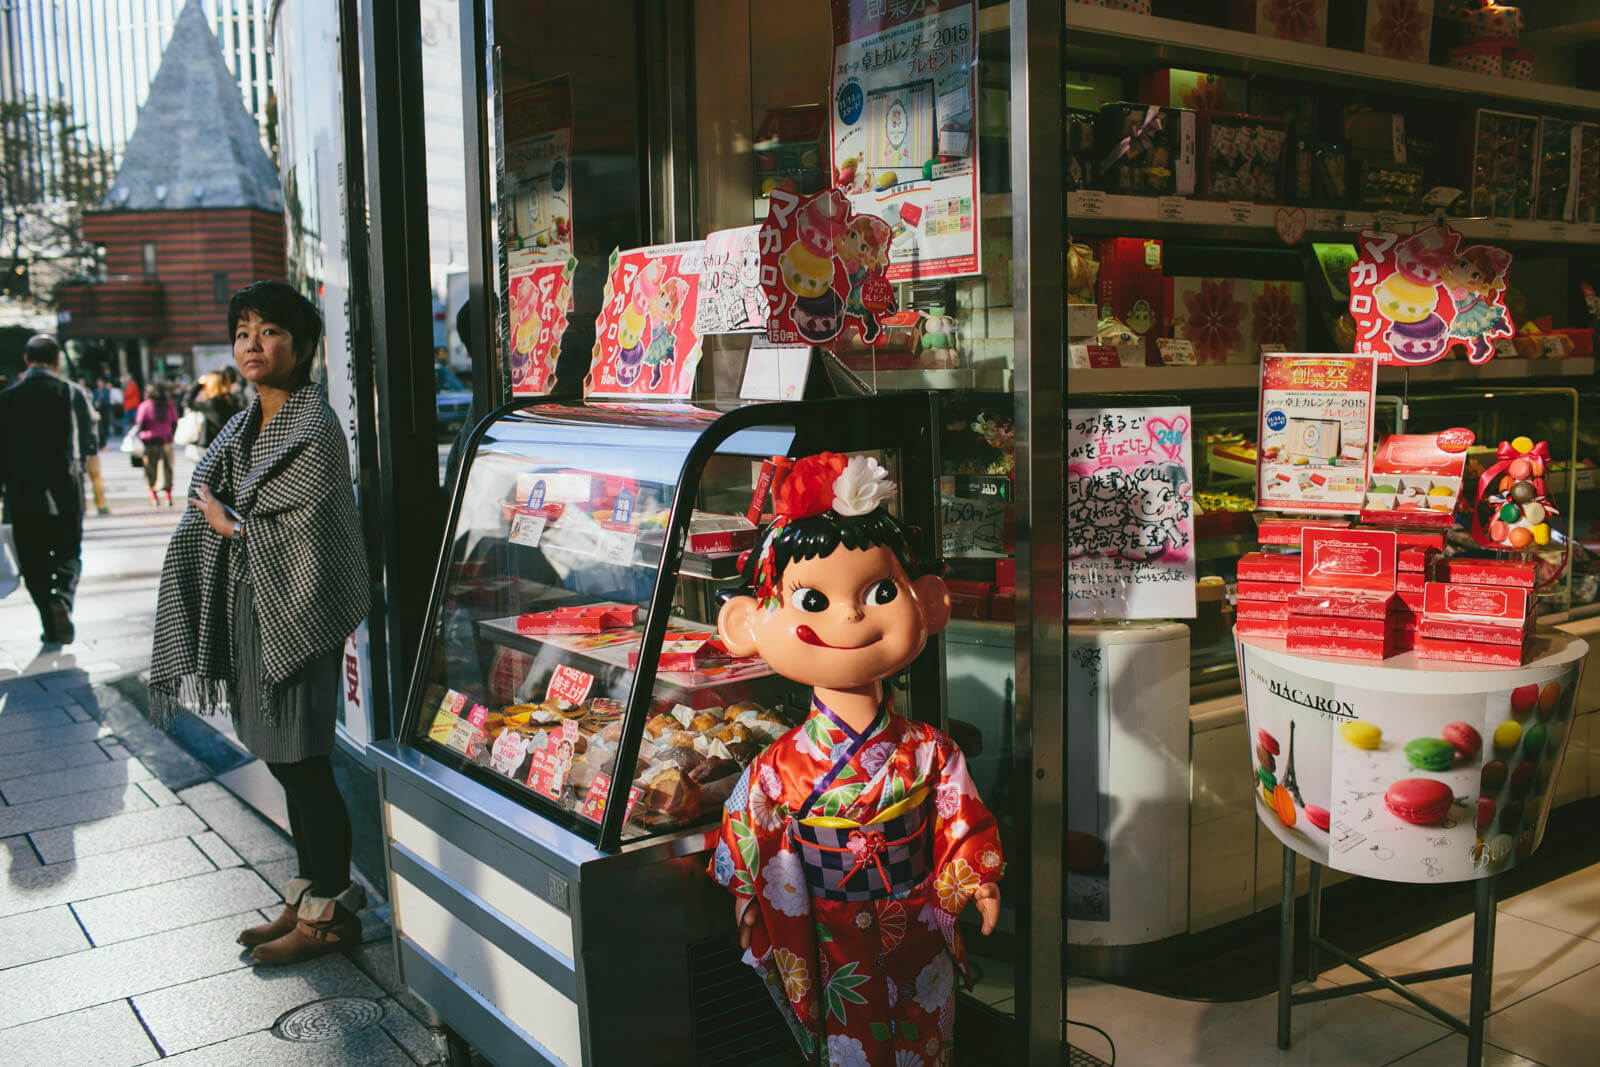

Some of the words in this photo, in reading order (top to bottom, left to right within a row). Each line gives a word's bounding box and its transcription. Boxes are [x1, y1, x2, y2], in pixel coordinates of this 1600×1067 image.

[862, 35, 929, 71] 卓上カレンダー
[933, 23, 968, 49] 2015
[759, 189, 799, 316] マカロン
[1350, 229, 1399, 340] マカロン
[608, 263, 639, 364] マカロン
[768, 331, 794, 342] 150円
[1291, 366, 1349, 389] 創業祭
[1285, 398, 1340, 409] 卓上カレンダー
[1341, 399, 1366, 408] 2015
[1268, 680, 1355, 716] MACARON
